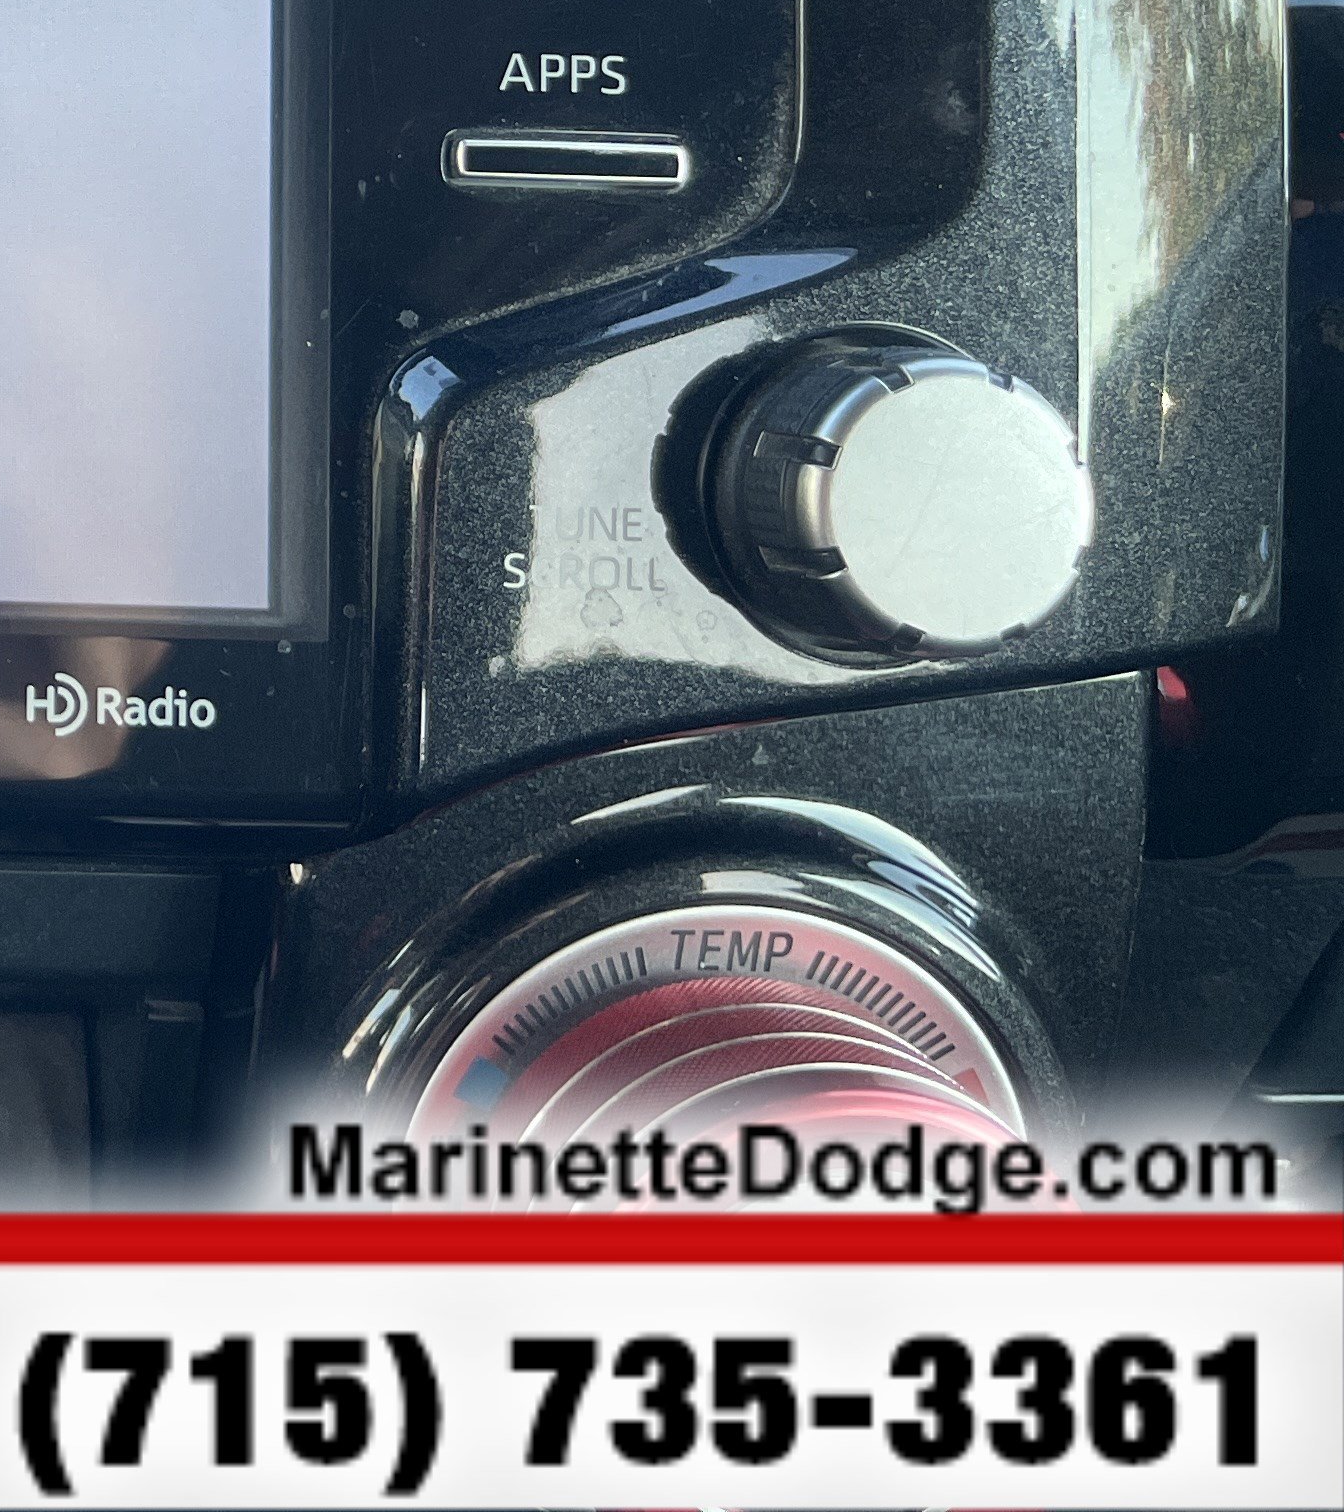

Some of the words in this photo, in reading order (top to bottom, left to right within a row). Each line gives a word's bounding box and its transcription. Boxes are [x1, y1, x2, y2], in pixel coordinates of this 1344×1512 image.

[499, 52, 628, 96] APPS
[529, 504, 644, 543] UNE
[503, 552, 667, 592] SROLL
[96, 685, 217, 728] Radio
[670, 929, 794, 973] TEMP
